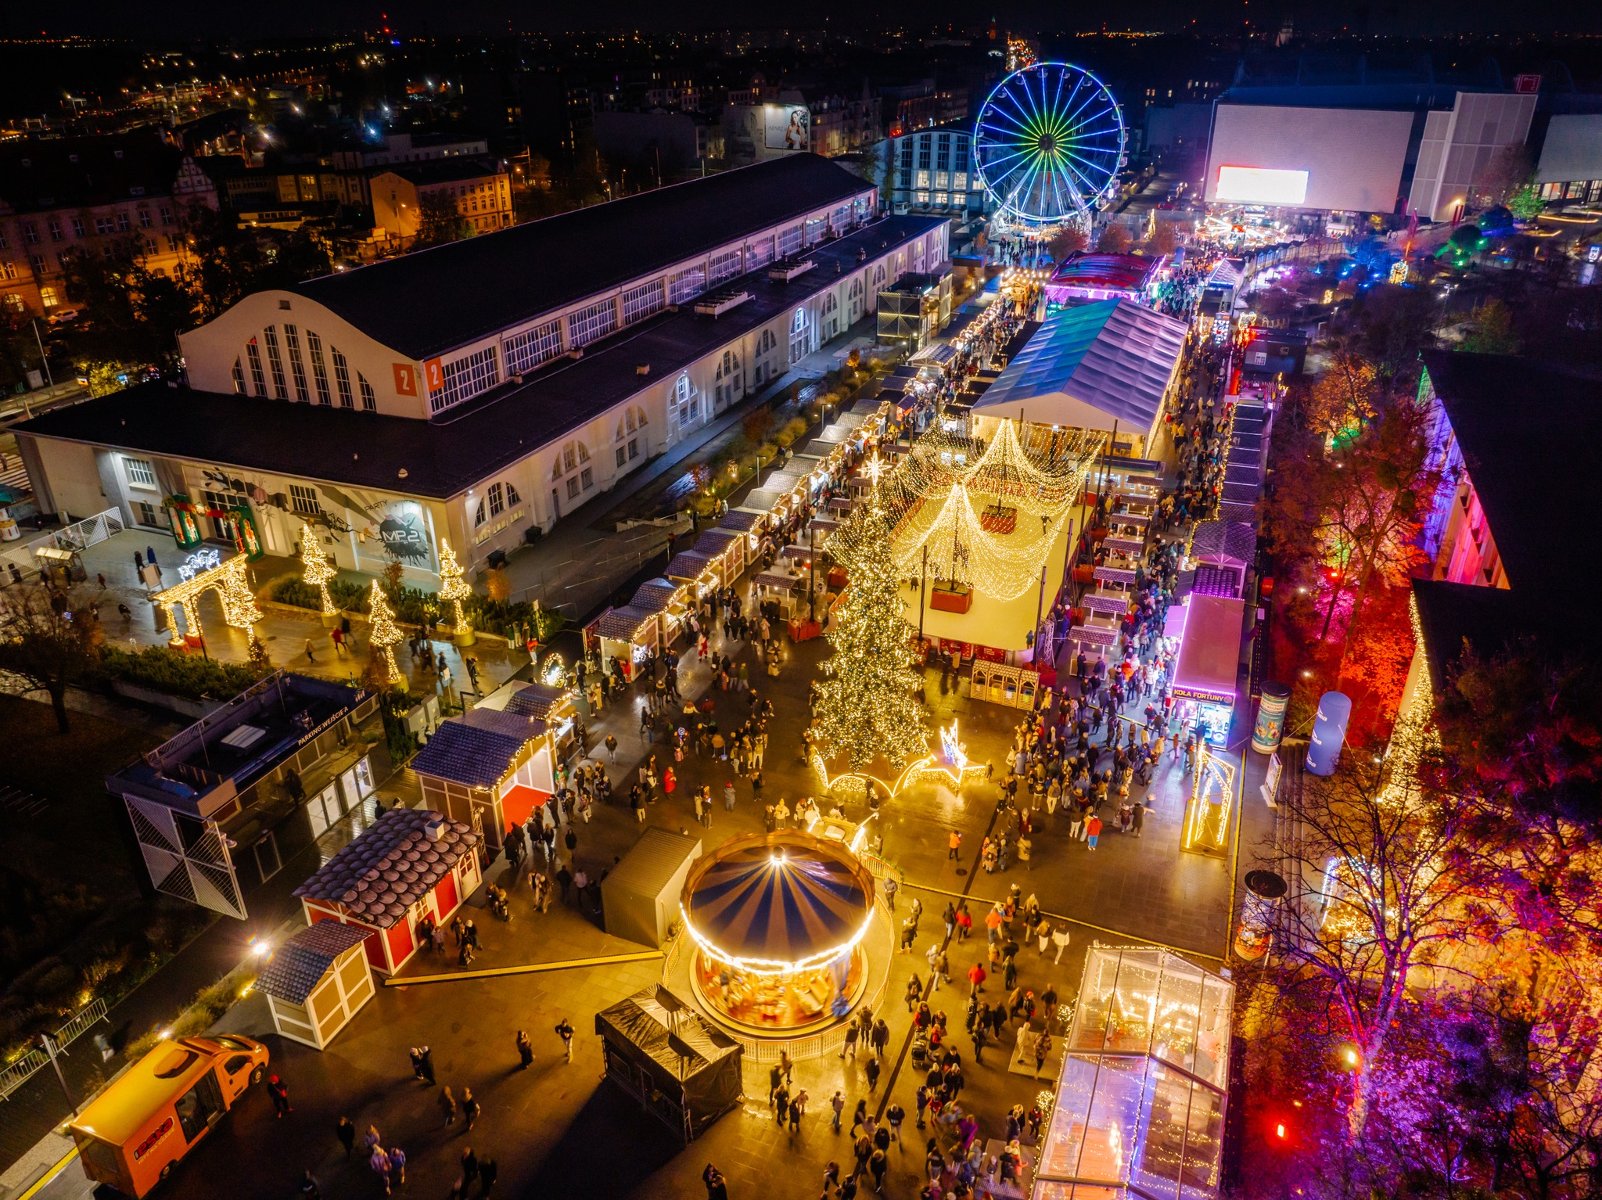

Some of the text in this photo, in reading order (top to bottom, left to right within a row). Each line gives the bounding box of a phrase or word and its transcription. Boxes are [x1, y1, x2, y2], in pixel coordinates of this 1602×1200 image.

[400, 370, 410, 390] 2
[431, 363, 439, 386] 2
[364, 499, 388, 512] PARTY
[1193, 692, 1224, 701] FORTUNY
[298, 725, 322, 745] PARKING
